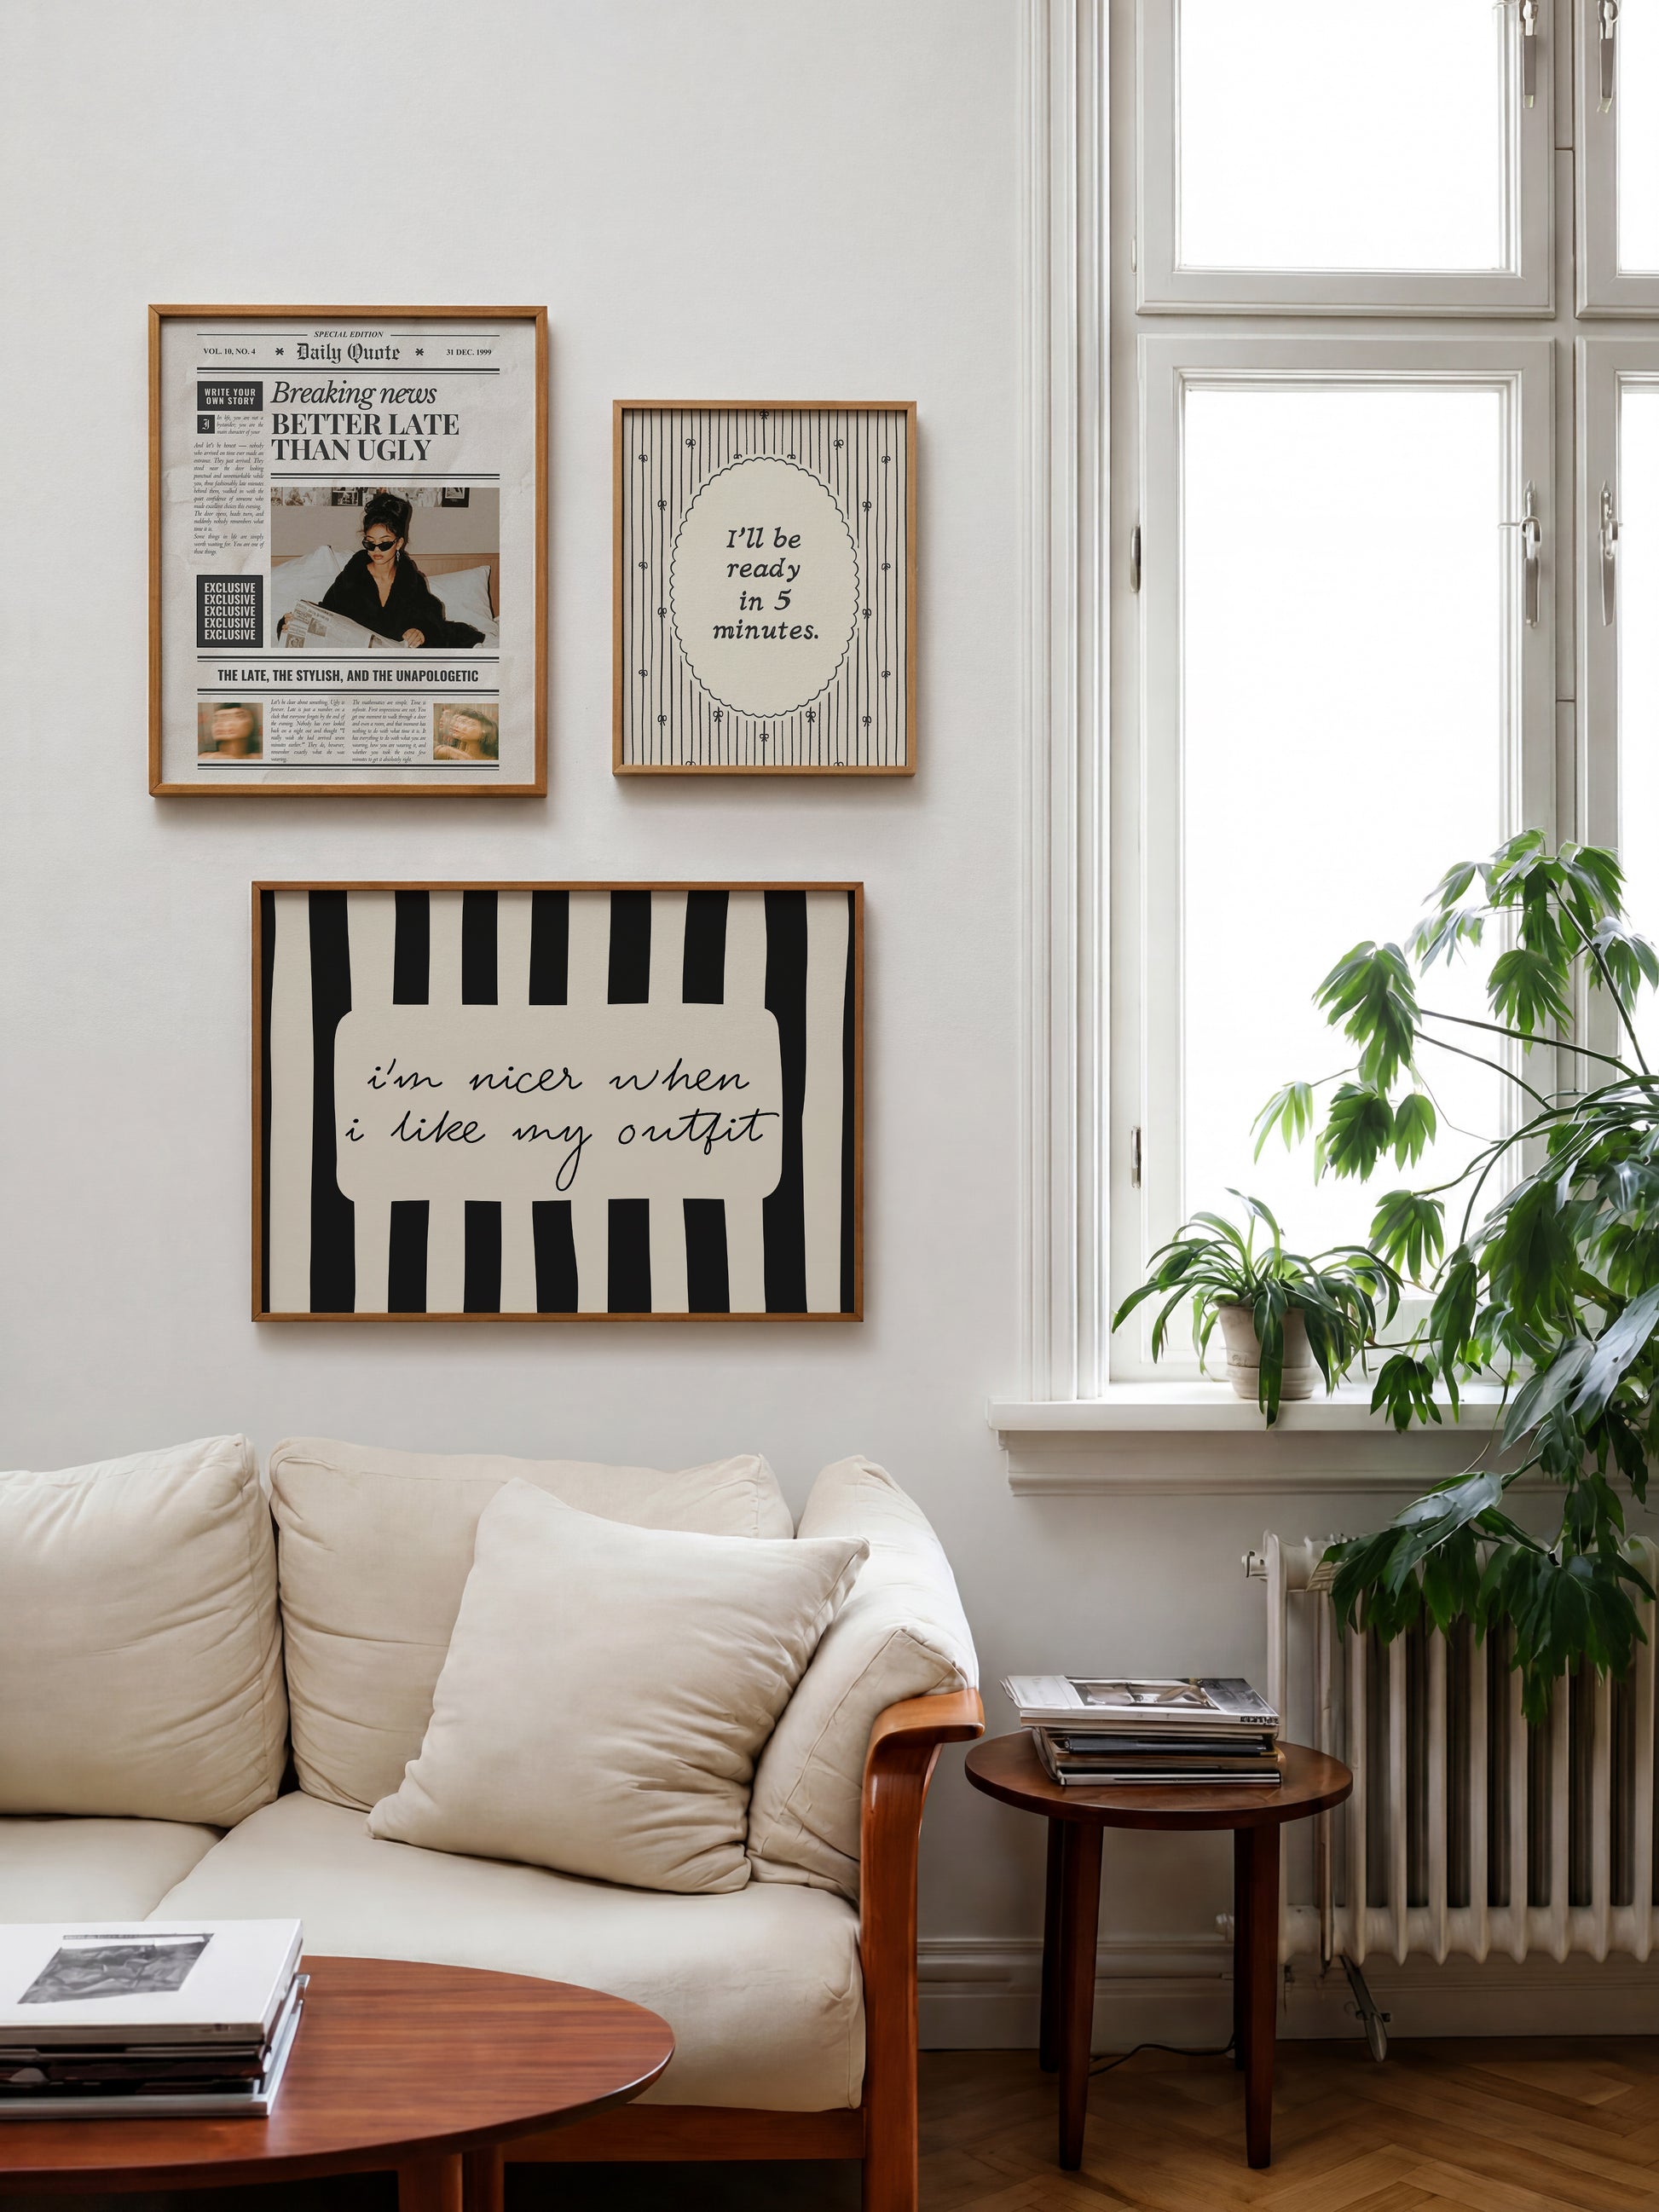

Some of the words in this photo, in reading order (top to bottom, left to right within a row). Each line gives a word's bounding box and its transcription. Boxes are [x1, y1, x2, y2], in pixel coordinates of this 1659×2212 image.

[298, 343, 341, 364] Daily
[348, 344, 400, 363] Quote
[204, 388, 230, 396] WRITE
[233, 388, 256, 396] YOUR
[228, 397, 255, 406] STORY
[270, 380, 376, 410] Breaking
[380, 388, 436, 403] news
[272, 413, 382, 435] BETTER
[389, 414, 459, 435] LATE
[271, 439, 350, 460] THAN
[358, 439, 431, 460] UGLY
[726, 527, 764, 548] I'll
[774, 527, 801, 548] be
[727, 557, 801, 582] ready
[205, 583, 255, 592] EXCLUSIVE
[205, 594, 255, 604] EXCLUSIVE
[740, 591, 764, 610] in
[774, 589, 791, 610] 5
[205, 606, 255, 616] EXCLUSIVE
[205, 618, 255, 628] EXCLUSIVE
[714, 619, 818, 639] minutes.
[205, 630, 255, 639] EXCLUSIVE
[217, 669, 239, 682] THE
[242, 670, 269, 683] LATE,
[272, 669, 293, 682] THE
[297, 670, 343, 683] STYLISH,
[346, 669, 369, 682] AND
[372, 669, 393, 682] THE
[396, 669, 479, 682] UNAPOLOGETIC
[367, 1059, 442, 1089] i'm
[470, 1066, 582, 1093] nicer
[609, 1058, 749, 1091] when
[345, 1118, 364, 1141] i
[390, 1111, 485, 1143] like
[512, 1124, 592, 1191] my
[618, 1108, 779, 1155] outfit
